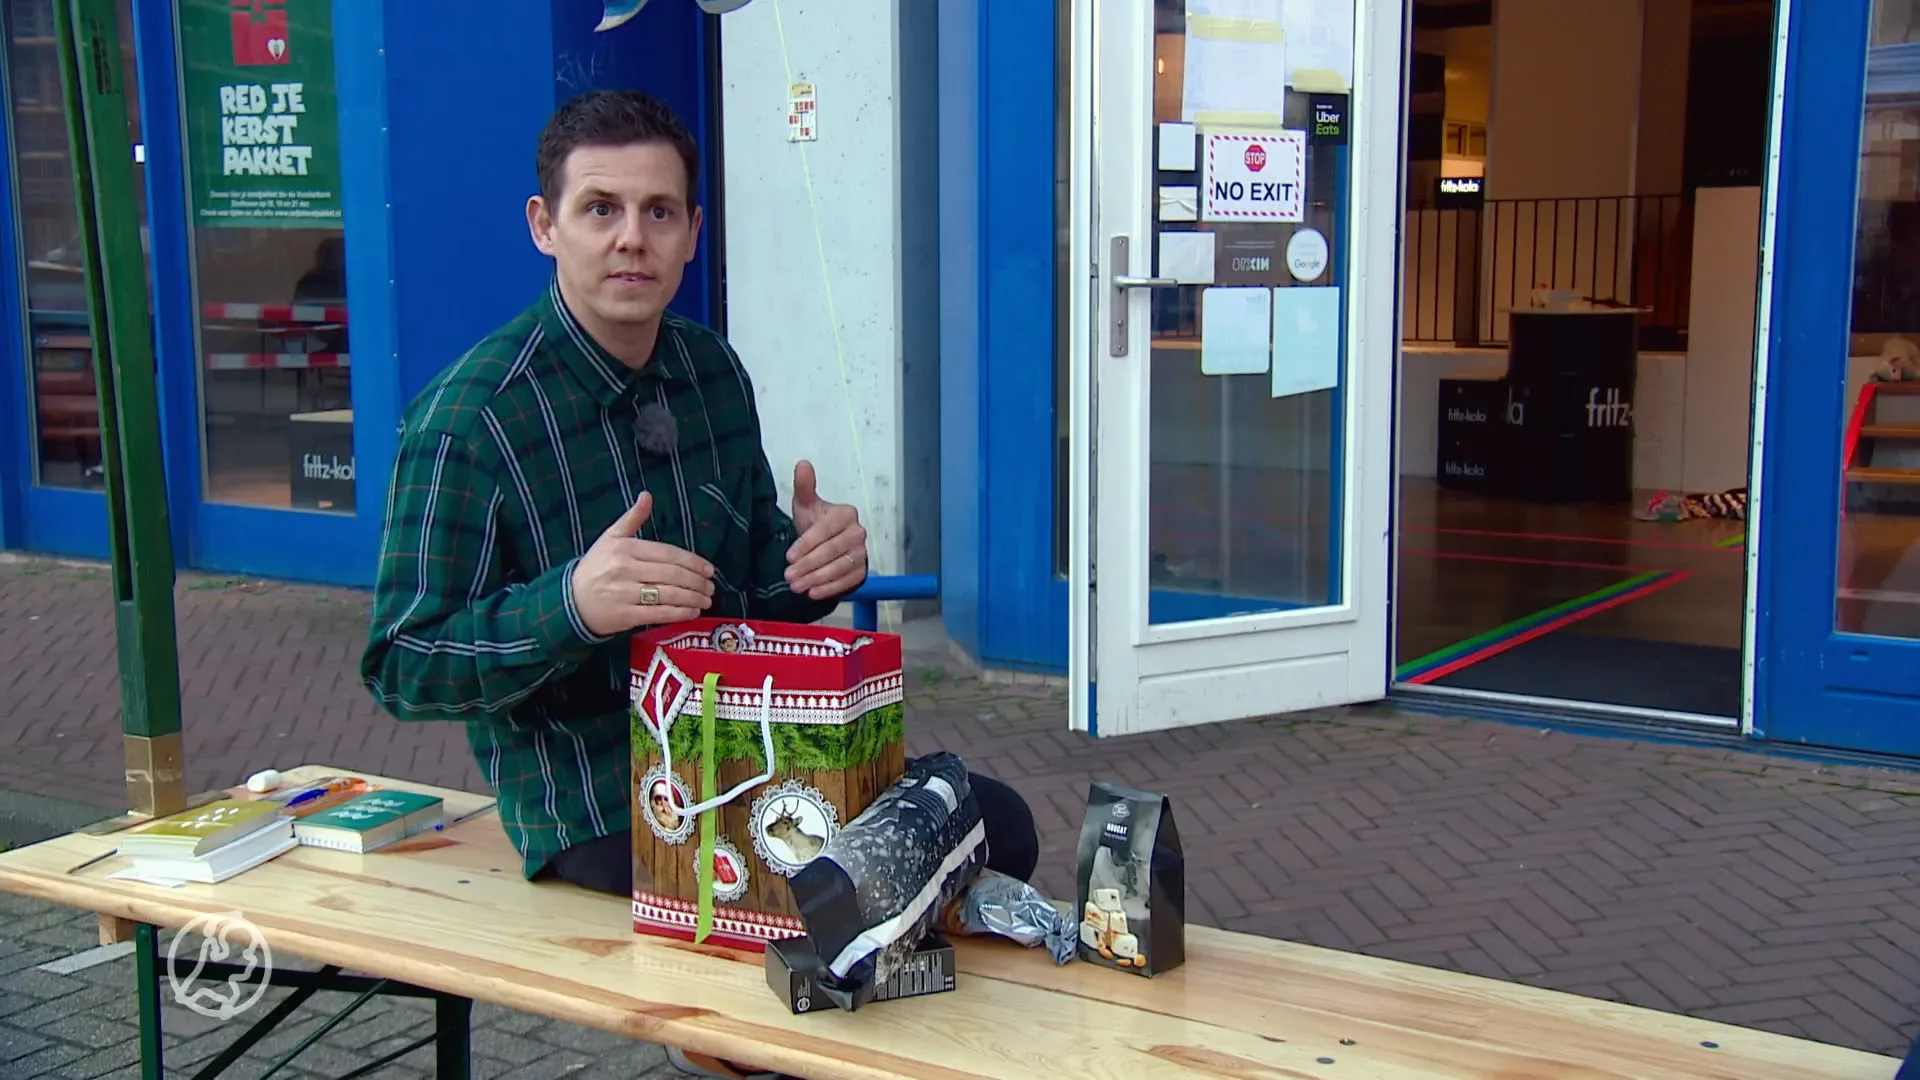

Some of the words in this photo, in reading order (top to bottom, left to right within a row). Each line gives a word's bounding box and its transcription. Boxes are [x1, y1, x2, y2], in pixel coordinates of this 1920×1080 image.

[220, 85, 267, 114] RED
[271, 83, 306, 113] JE
[1316, 111, 1340, 123] Uber
[222, 115, 298, 145] KERST
[1316, 124, 1340, 136] Eats
[223, 146, 312, 176] PAKKET
[1244, 151, 1266, 165] STOP
[1215, 181, 1244, 200] NO
[1250, 182, 1294, 201] EXIT
[1448, 408, 1486, 422] fritz-kola
